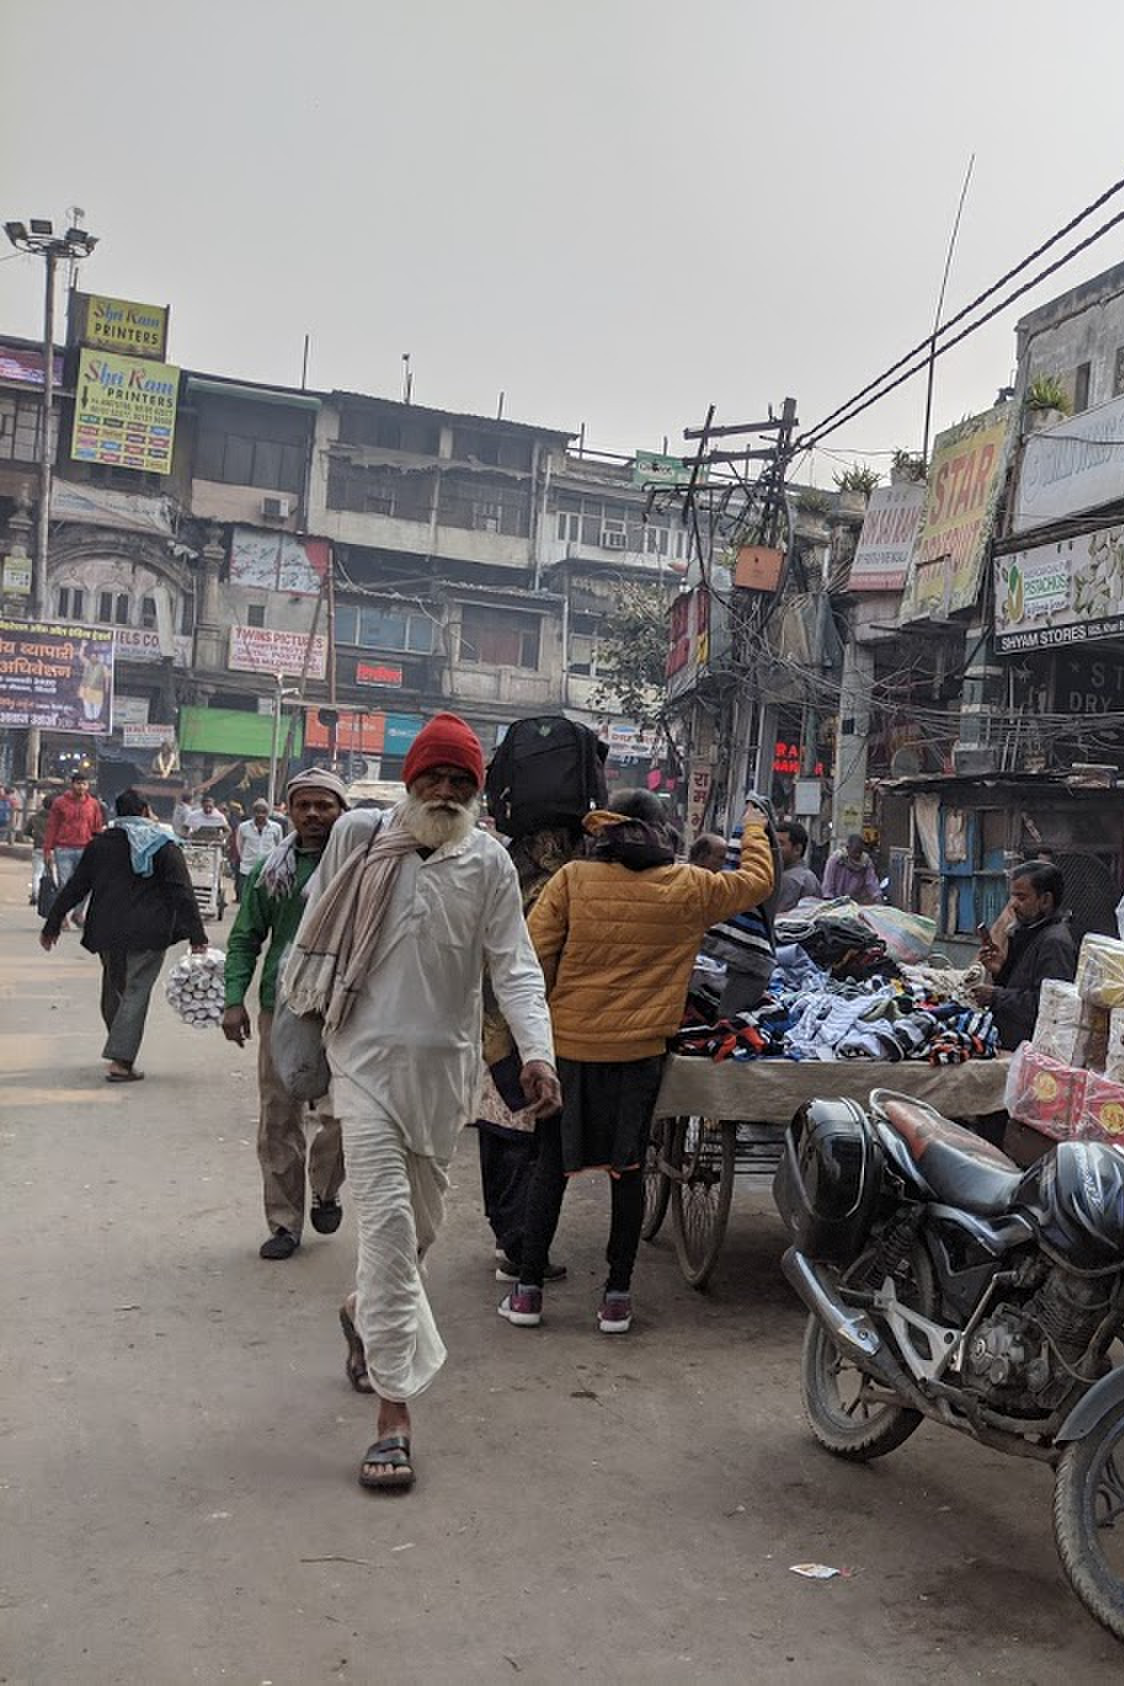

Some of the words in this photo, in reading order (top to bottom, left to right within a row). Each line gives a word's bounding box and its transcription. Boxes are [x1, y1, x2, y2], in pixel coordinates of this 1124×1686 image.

[94, 302, 124, 323] Shri
[126, 308, 160, 328] Ram
[95, 322, 159, 345] PRINTERS
[84, 359, 124, 389] Shri
[127, 366, 174, 396] Ram
[107, 387, 174, 408] PRINTERS
[929, 443, 995, 526] STAR
[1001, 633, 1038, 651] SHYAM
[1040, 625, 1087, 645] STORES
